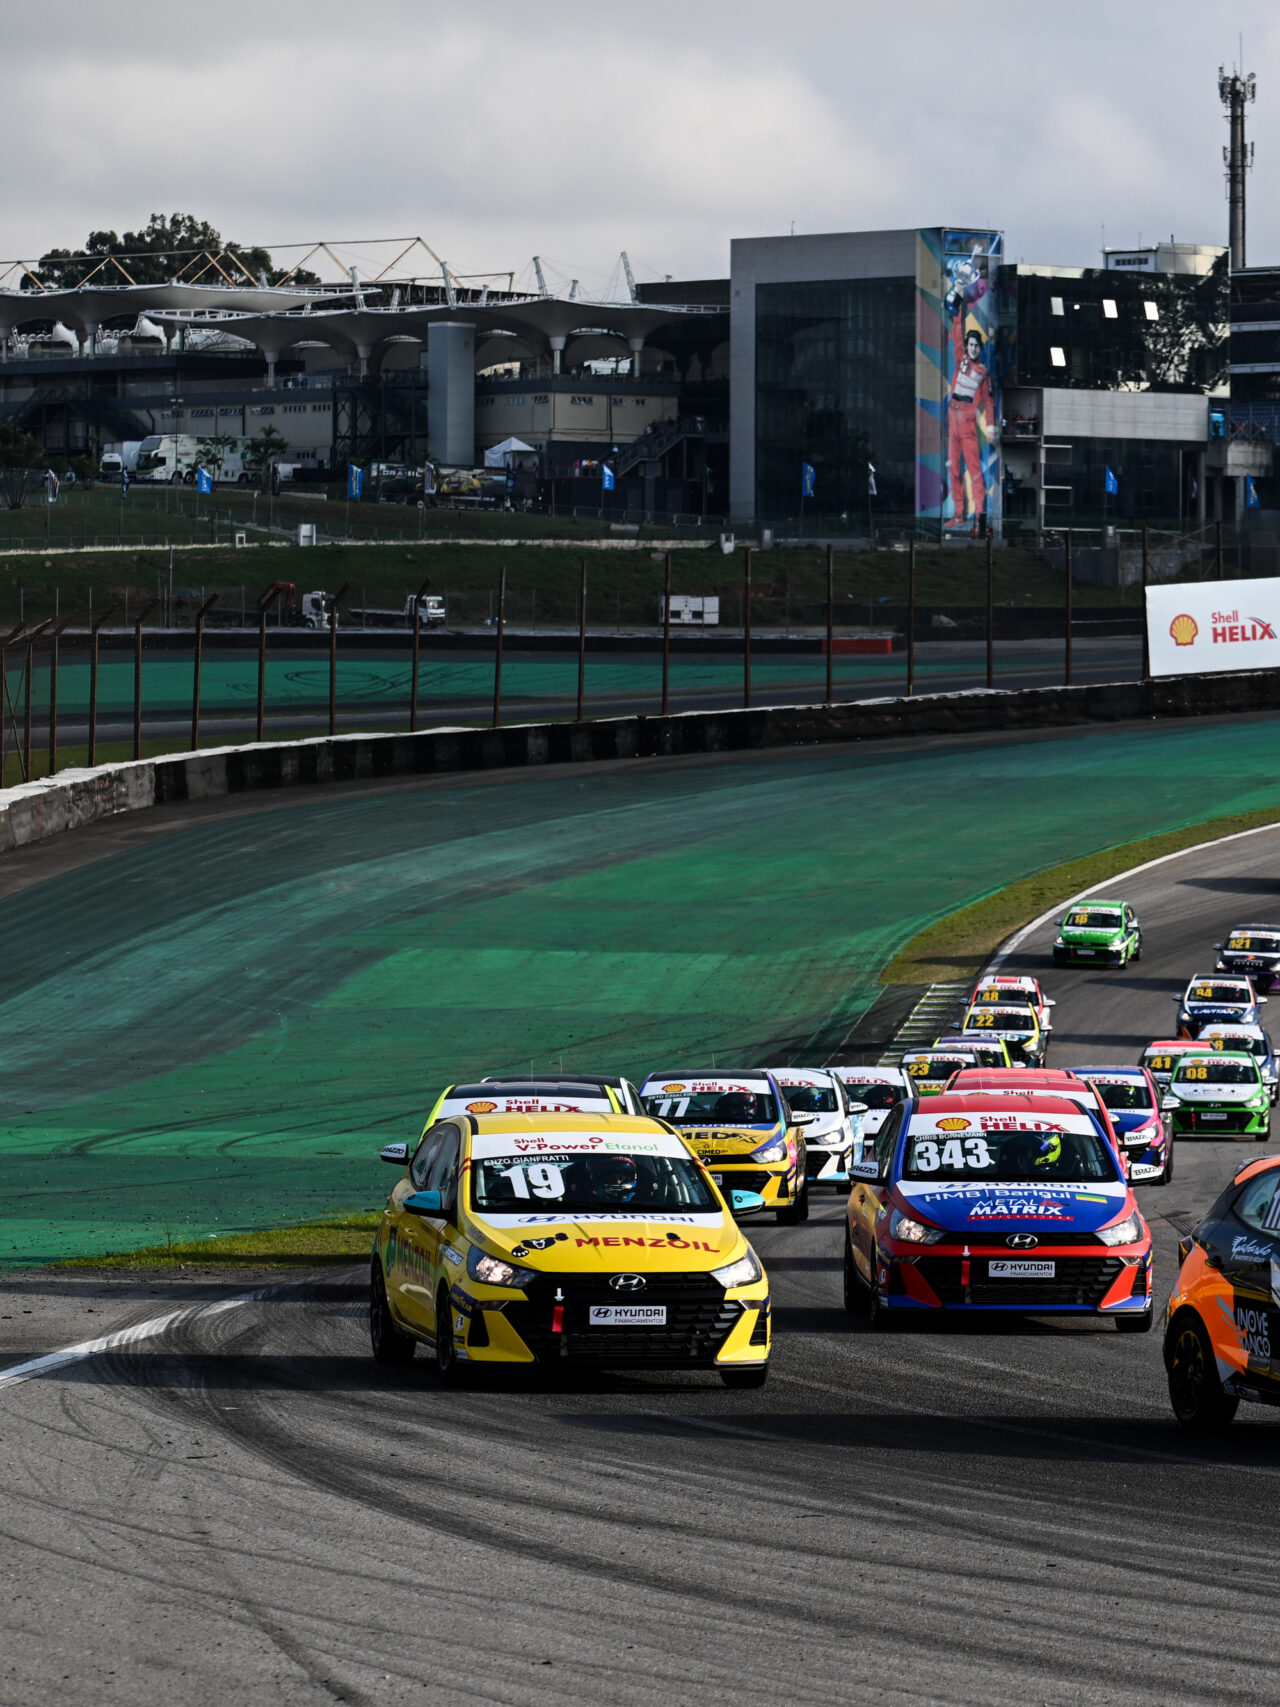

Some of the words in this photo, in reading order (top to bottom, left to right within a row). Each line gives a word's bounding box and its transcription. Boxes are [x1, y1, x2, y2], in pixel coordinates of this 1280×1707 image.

[1211, 610, 1239, 625] Shell
[1212, 617, 1278, 644] HELIX
[1230, 938, 1251, 949] 121
[982, 991, 999, 1002] 48
[976, 1015, 994, 1027] 22
[1151, 1056, 1171, 1069] 41
[908, 1063, 929, 1076] 23
[1186, 1067, 1207, 1080] 08
[692, 1084, 751, 1093] HELIX
[505, 1103, 581, 1113] HELIX
[654, 1097, 691, 1117] 77
[979, 1120, 1068, 1132] HELIX
[513, 1137, 545, 1145] Shell
[914, 1134, 938, 1142] CHRIS
[939, 1132, 987, 1140] BORNEMANN
[514, 1143, 599, 1151] V-Power
[604, 1142, 658, 1151] Etanol
[484, 1157, 511, 1166] ENZO
[512, 1154, 570, 1164] GIANFRATTI
[914, 1138, 991, 1172] 343
[500, 1163, 566, 1200] 19
[925, 1189, 981, 1202] HMB
[994, 1189, 1071, 1199] Barigui
[976, 1199, 1039, 1207] METAL
[969, 1205, 1063, 1216] MATRIX
[572, 1214, 695, 1223] HYUNDAI
[575, 1237, 720, 1253] MENZOIL
[1010, 1263, 1053, 1271] HYUNDAI
[614, 1309, 664, 1317] HYUNDAI
[1237, 1307, 1269, 1336] INOVE
